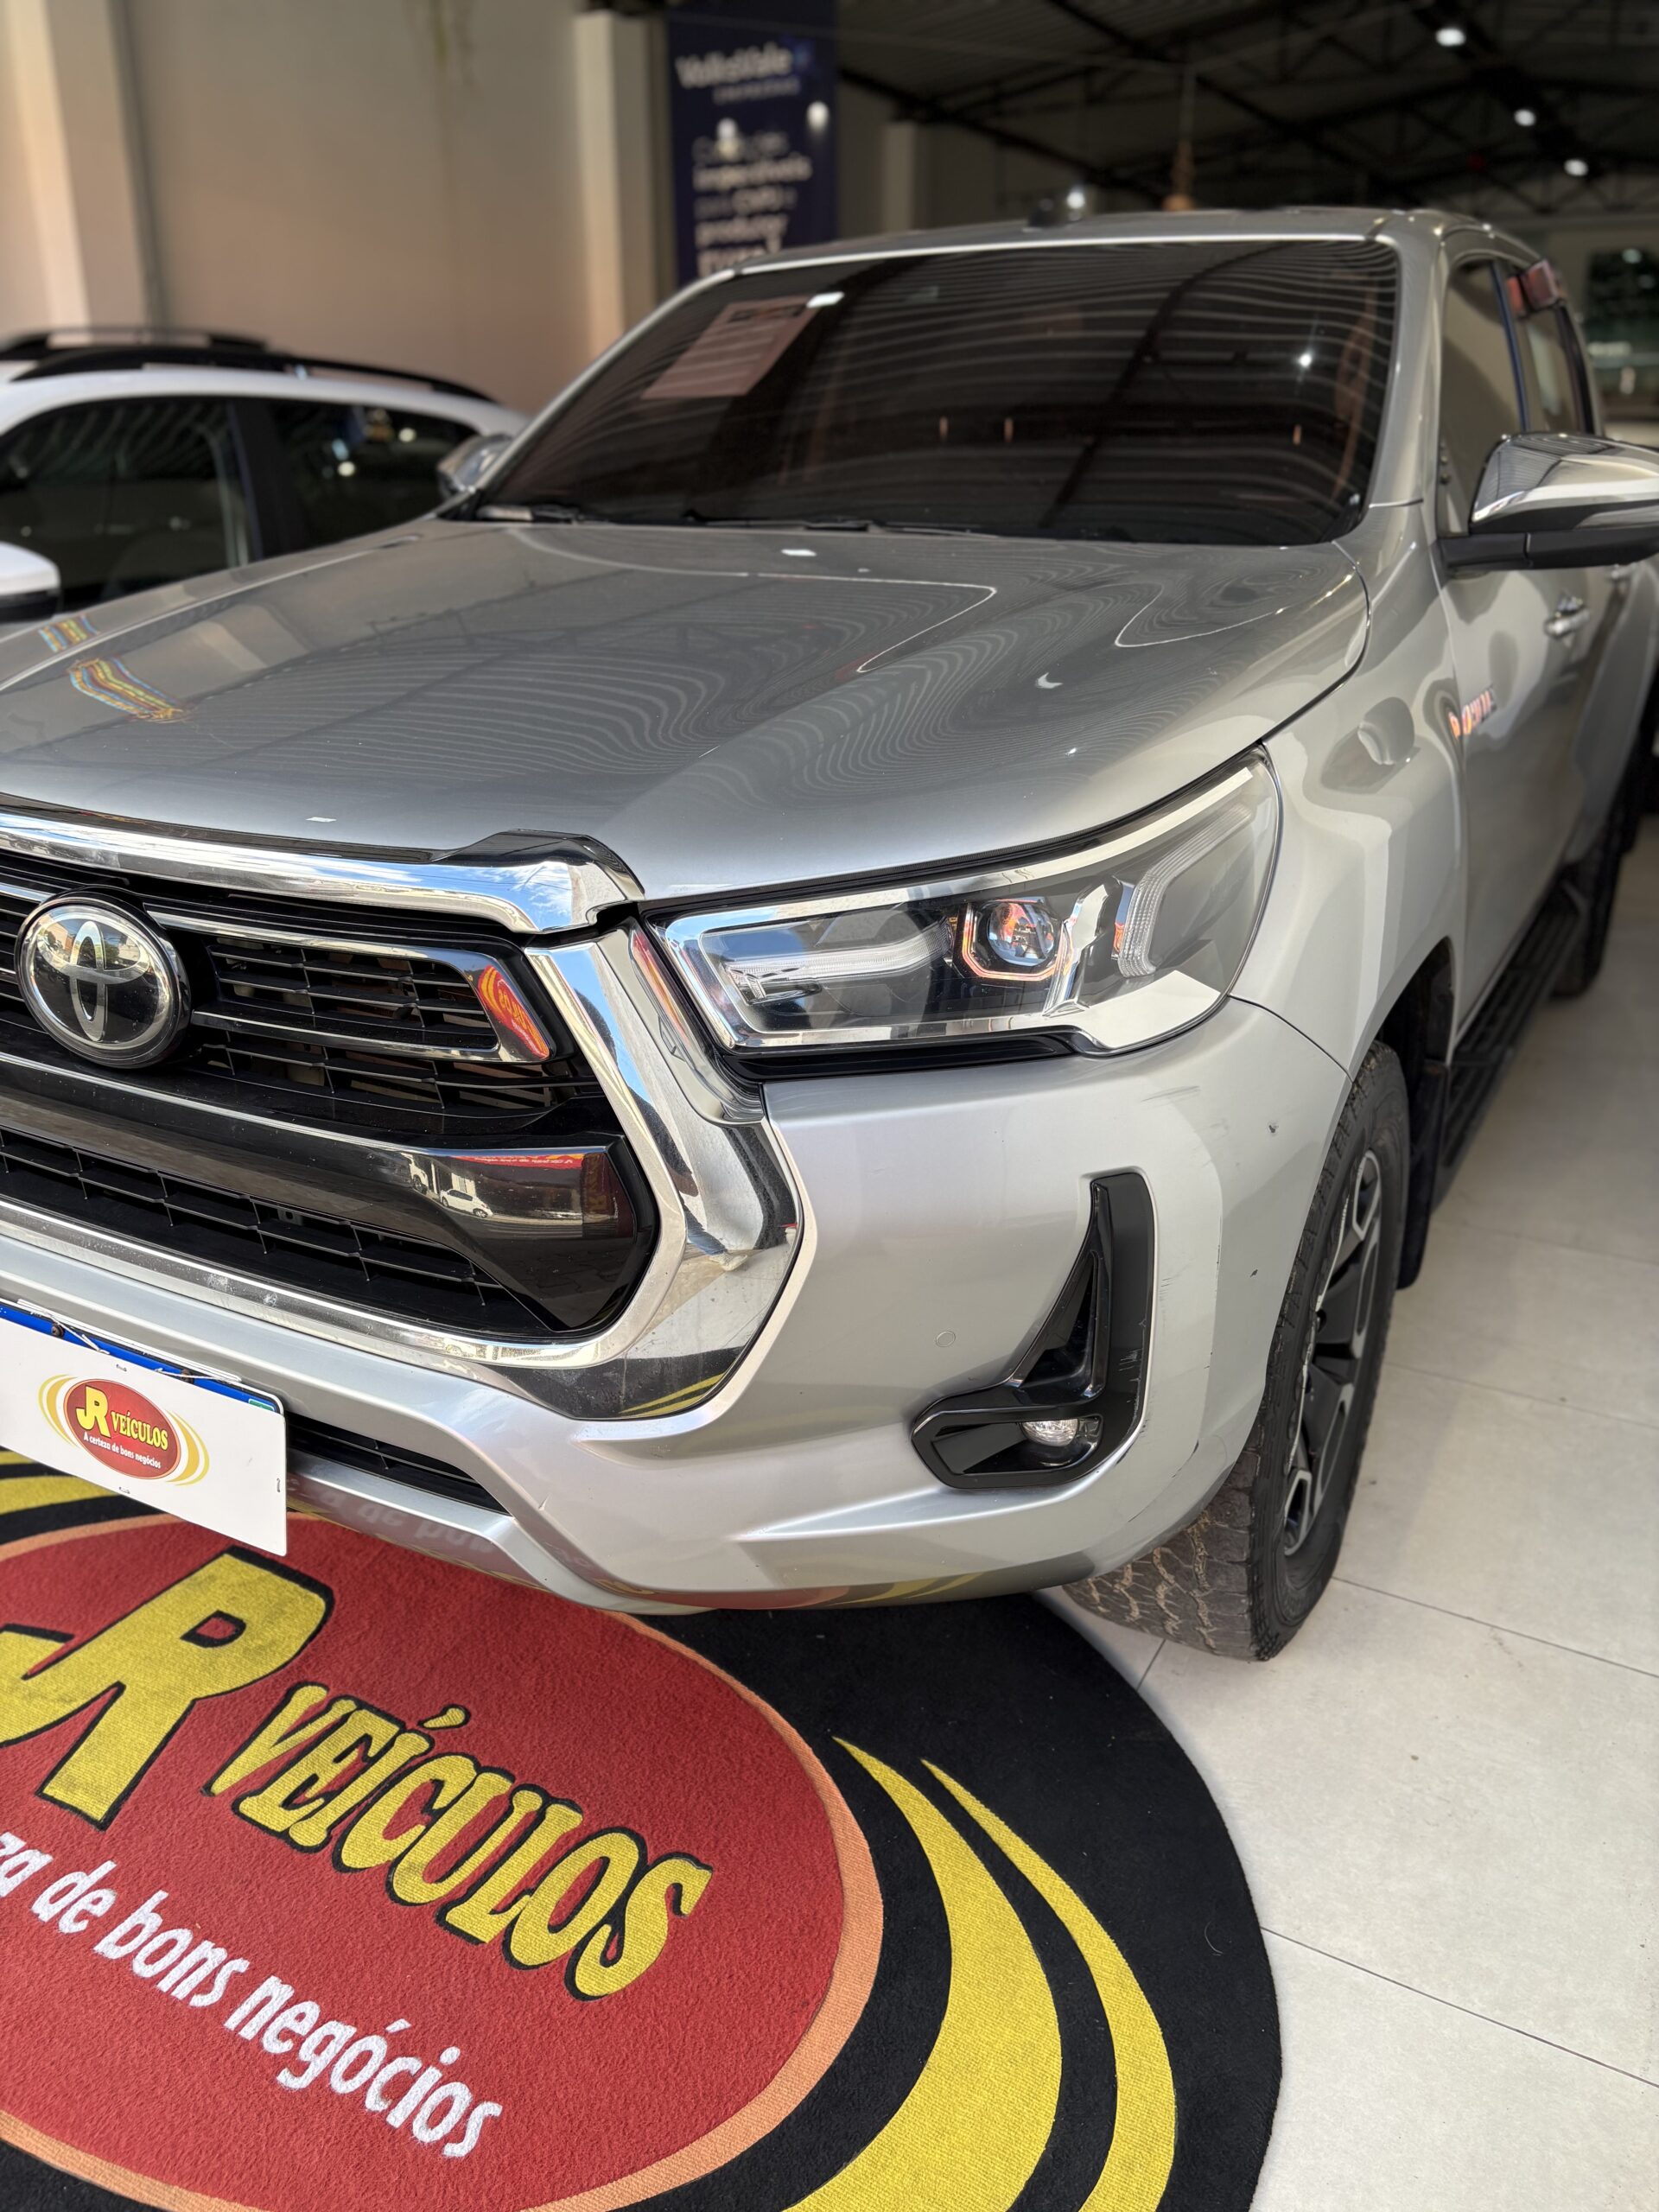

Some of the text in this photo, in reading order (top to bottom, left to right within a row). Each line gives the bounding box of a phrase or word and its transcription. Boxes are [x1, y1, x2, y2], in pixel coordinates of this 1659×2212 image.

[75, 1385, 168, 1451] JR VEÍCULOS
[83, 1431, 161, 1469] A certeza de bons negócios
[200, 1681, 713, 2001] VEÍCULOS
[31, 1860, 116, 1934] de
[94, 1890, 251, 2009] bons
[223, 1974, 504, 2159] negócios
